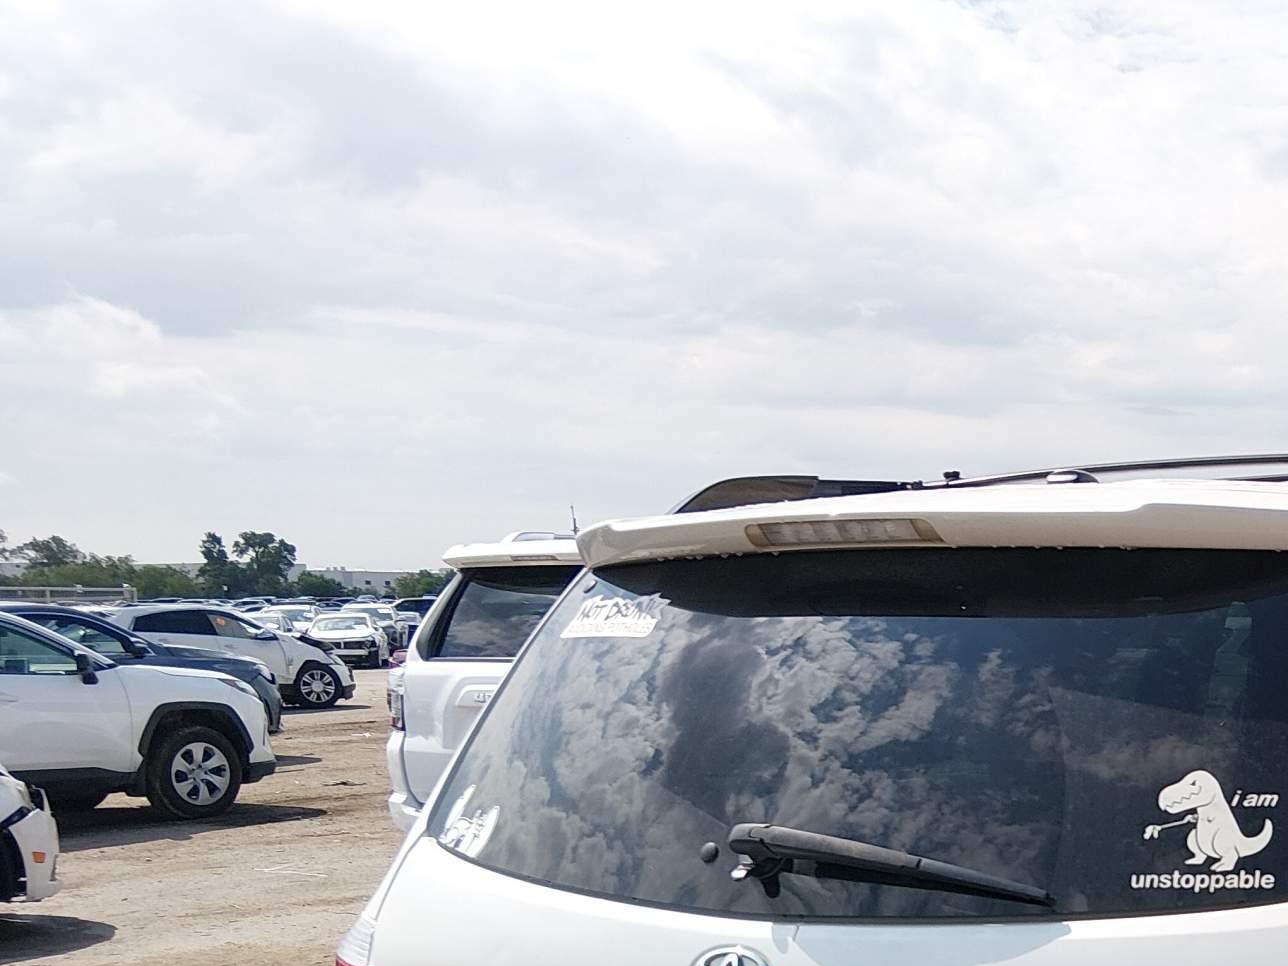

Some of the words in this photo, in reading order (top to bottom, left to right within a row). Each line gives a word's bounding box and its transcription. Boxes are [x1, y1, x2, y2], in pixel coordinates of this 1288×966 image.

[1231, 790, 1242, 807] i
[1243, 793, 1279, 807] am
[1131, 870, 1276, 893] unstoppable
